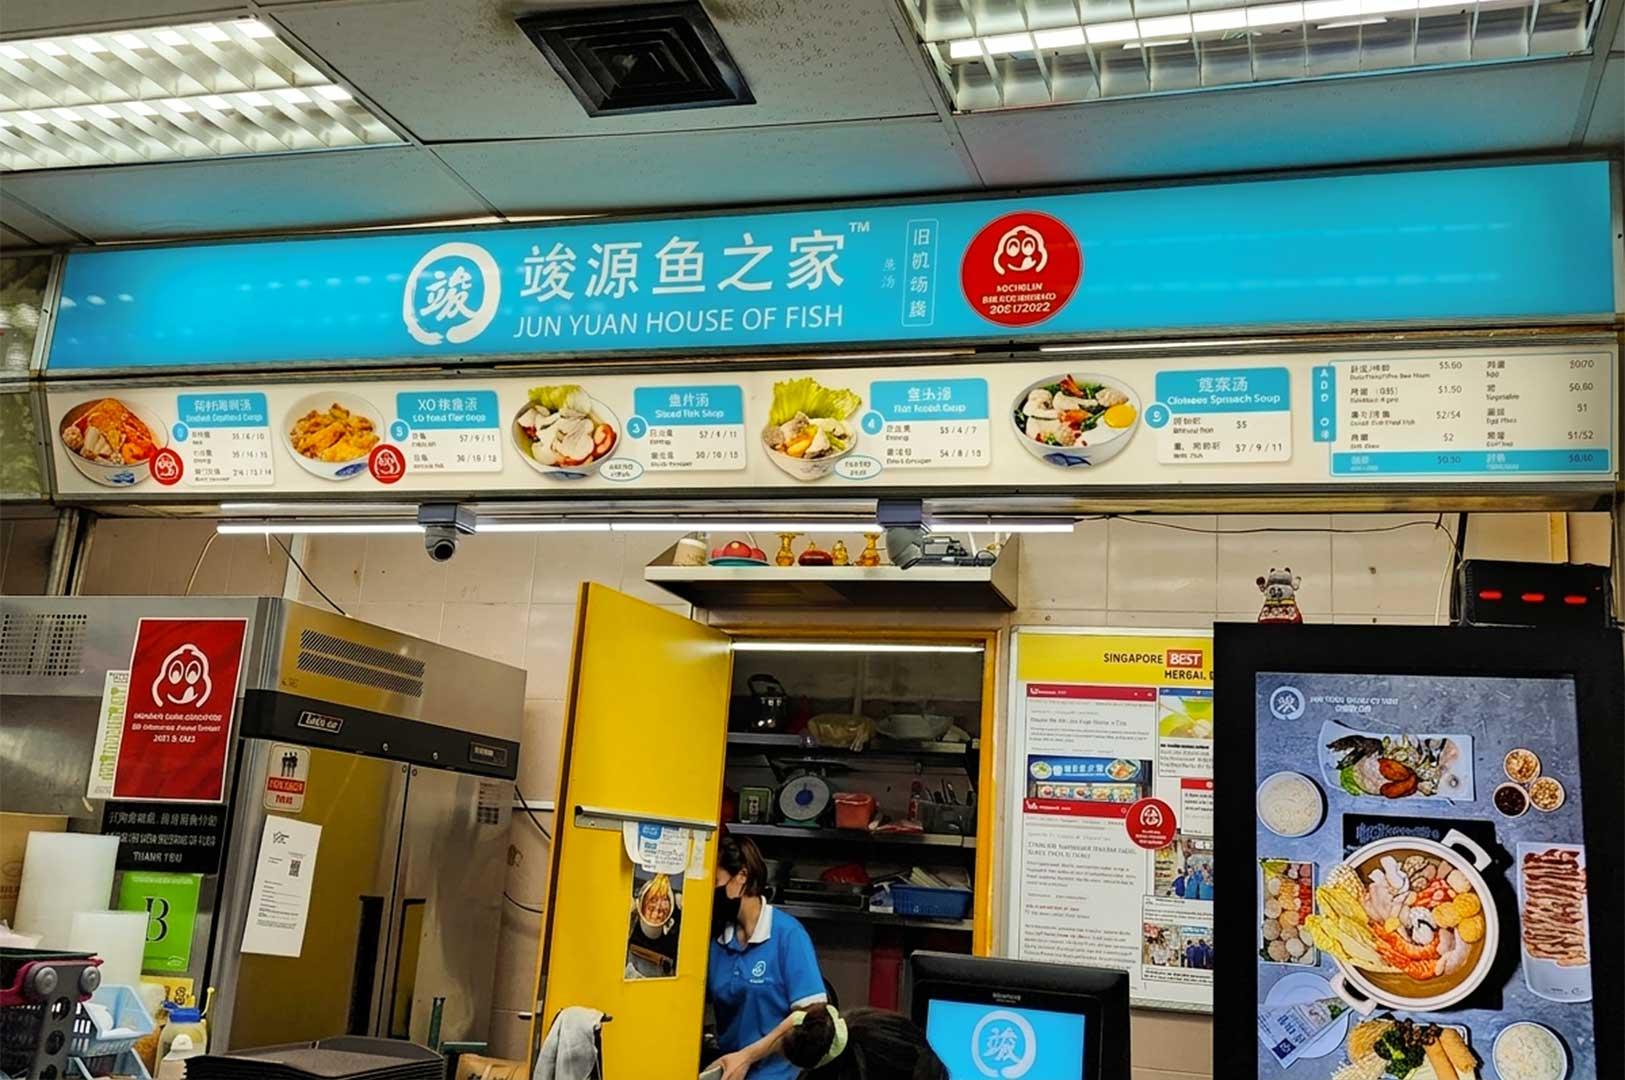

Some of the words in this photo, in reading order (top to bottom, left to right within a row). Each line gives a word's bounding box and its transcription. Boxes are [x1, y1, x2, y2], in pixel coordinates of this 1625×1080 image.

[520, 229, 845, 302] 竣源鱼之家
[849, 222, 870, 233] TM
[513, 316, 561, 338] JUN
[569, 313, 637, 336] YUAN
[646, 309, 734, 333] HOUSE
[742, 306, 776, 331] OF
[786, 304, 844, 329] FISH
[418, 398, 436, 411] XO
[1254, 393, 1280, 404] Soup
[632, 423, 641, 434] 3
[1272, 443, 1282, 452] 11
[1103, 653, 1164, 664] SINGAPORE
[1170, 653, 1202, 665] BEST
[145, 896, 170, 942] B
